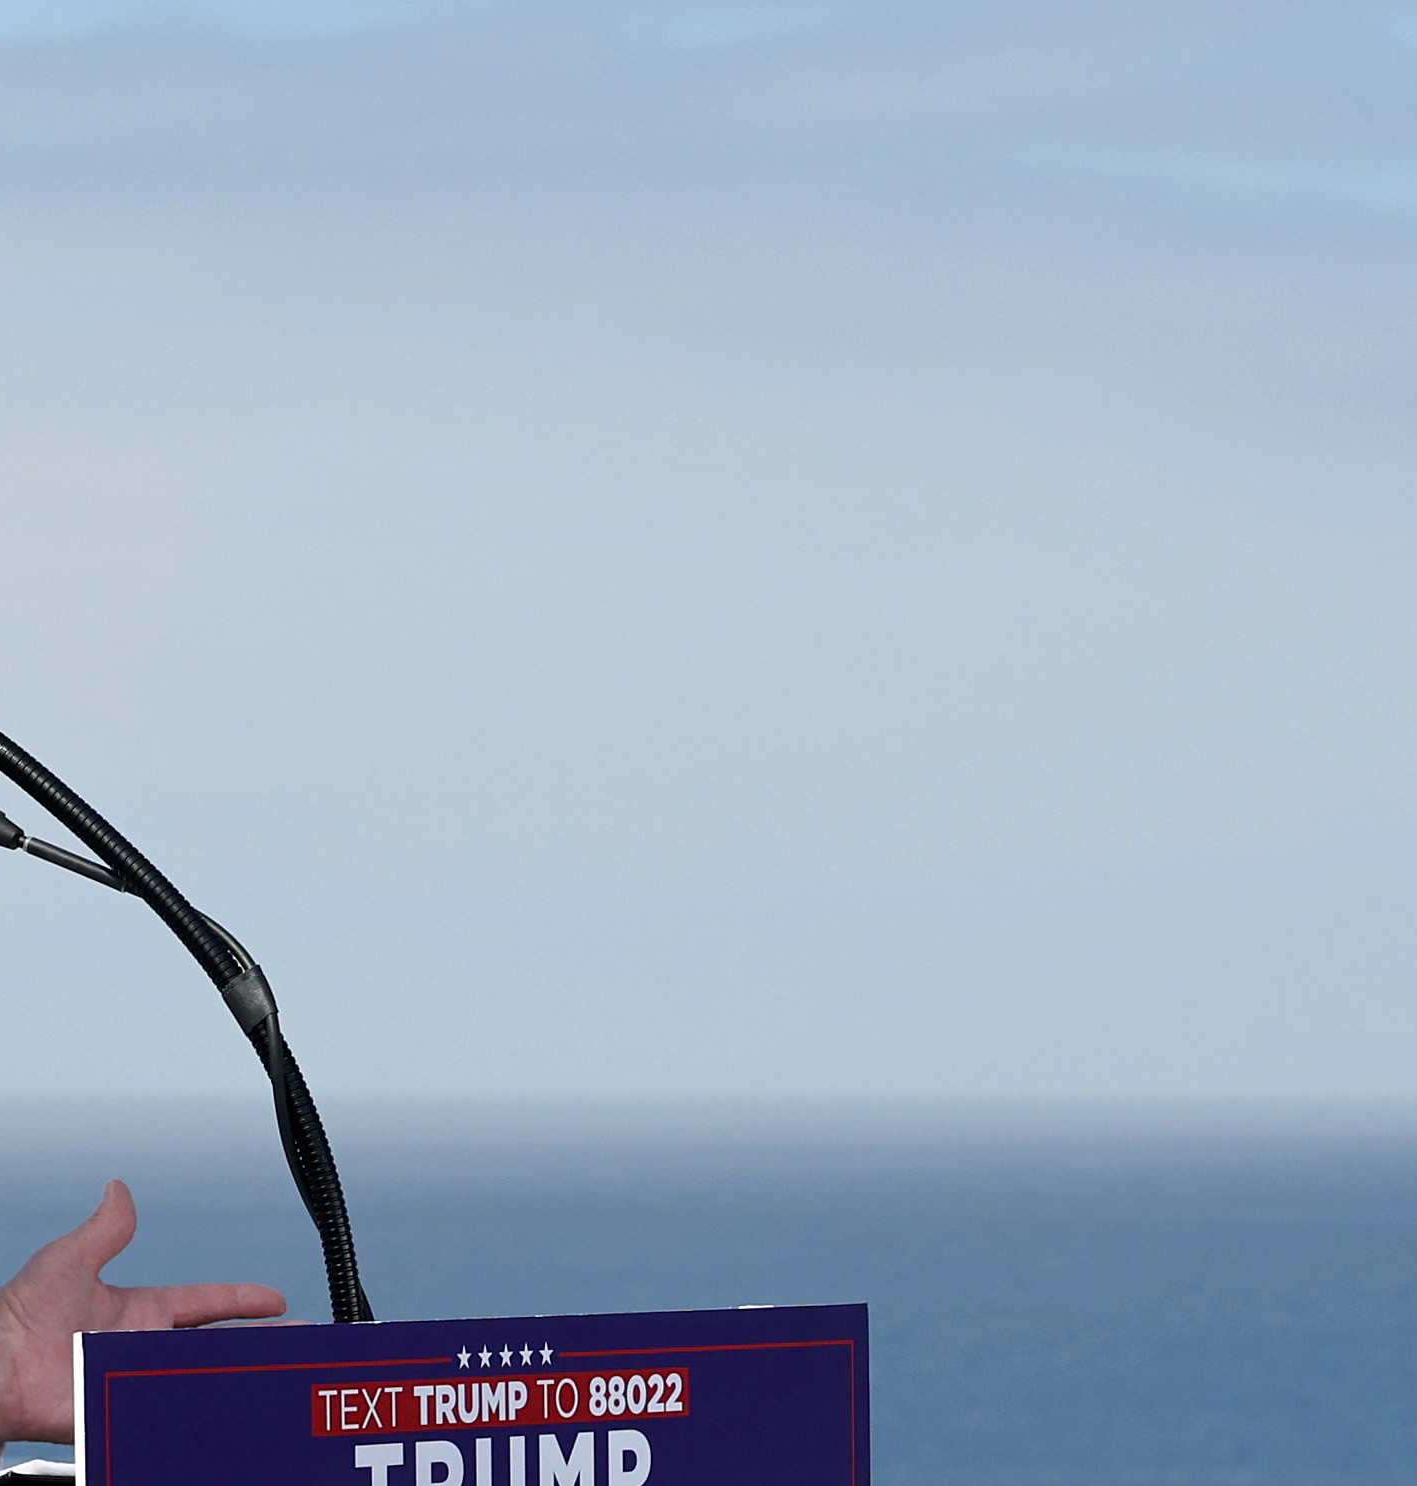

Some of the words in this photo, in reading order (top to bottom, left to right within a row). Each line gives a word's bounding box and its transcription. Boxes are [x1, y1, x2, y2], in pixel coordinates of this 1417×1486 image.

[318, 1386, 404, 1431] TEXT
[413, 1381, 528, 1426] TRUMP
[536, 1379, 579, 1419] TO
[588, 1372, 683, 1417] 88022
